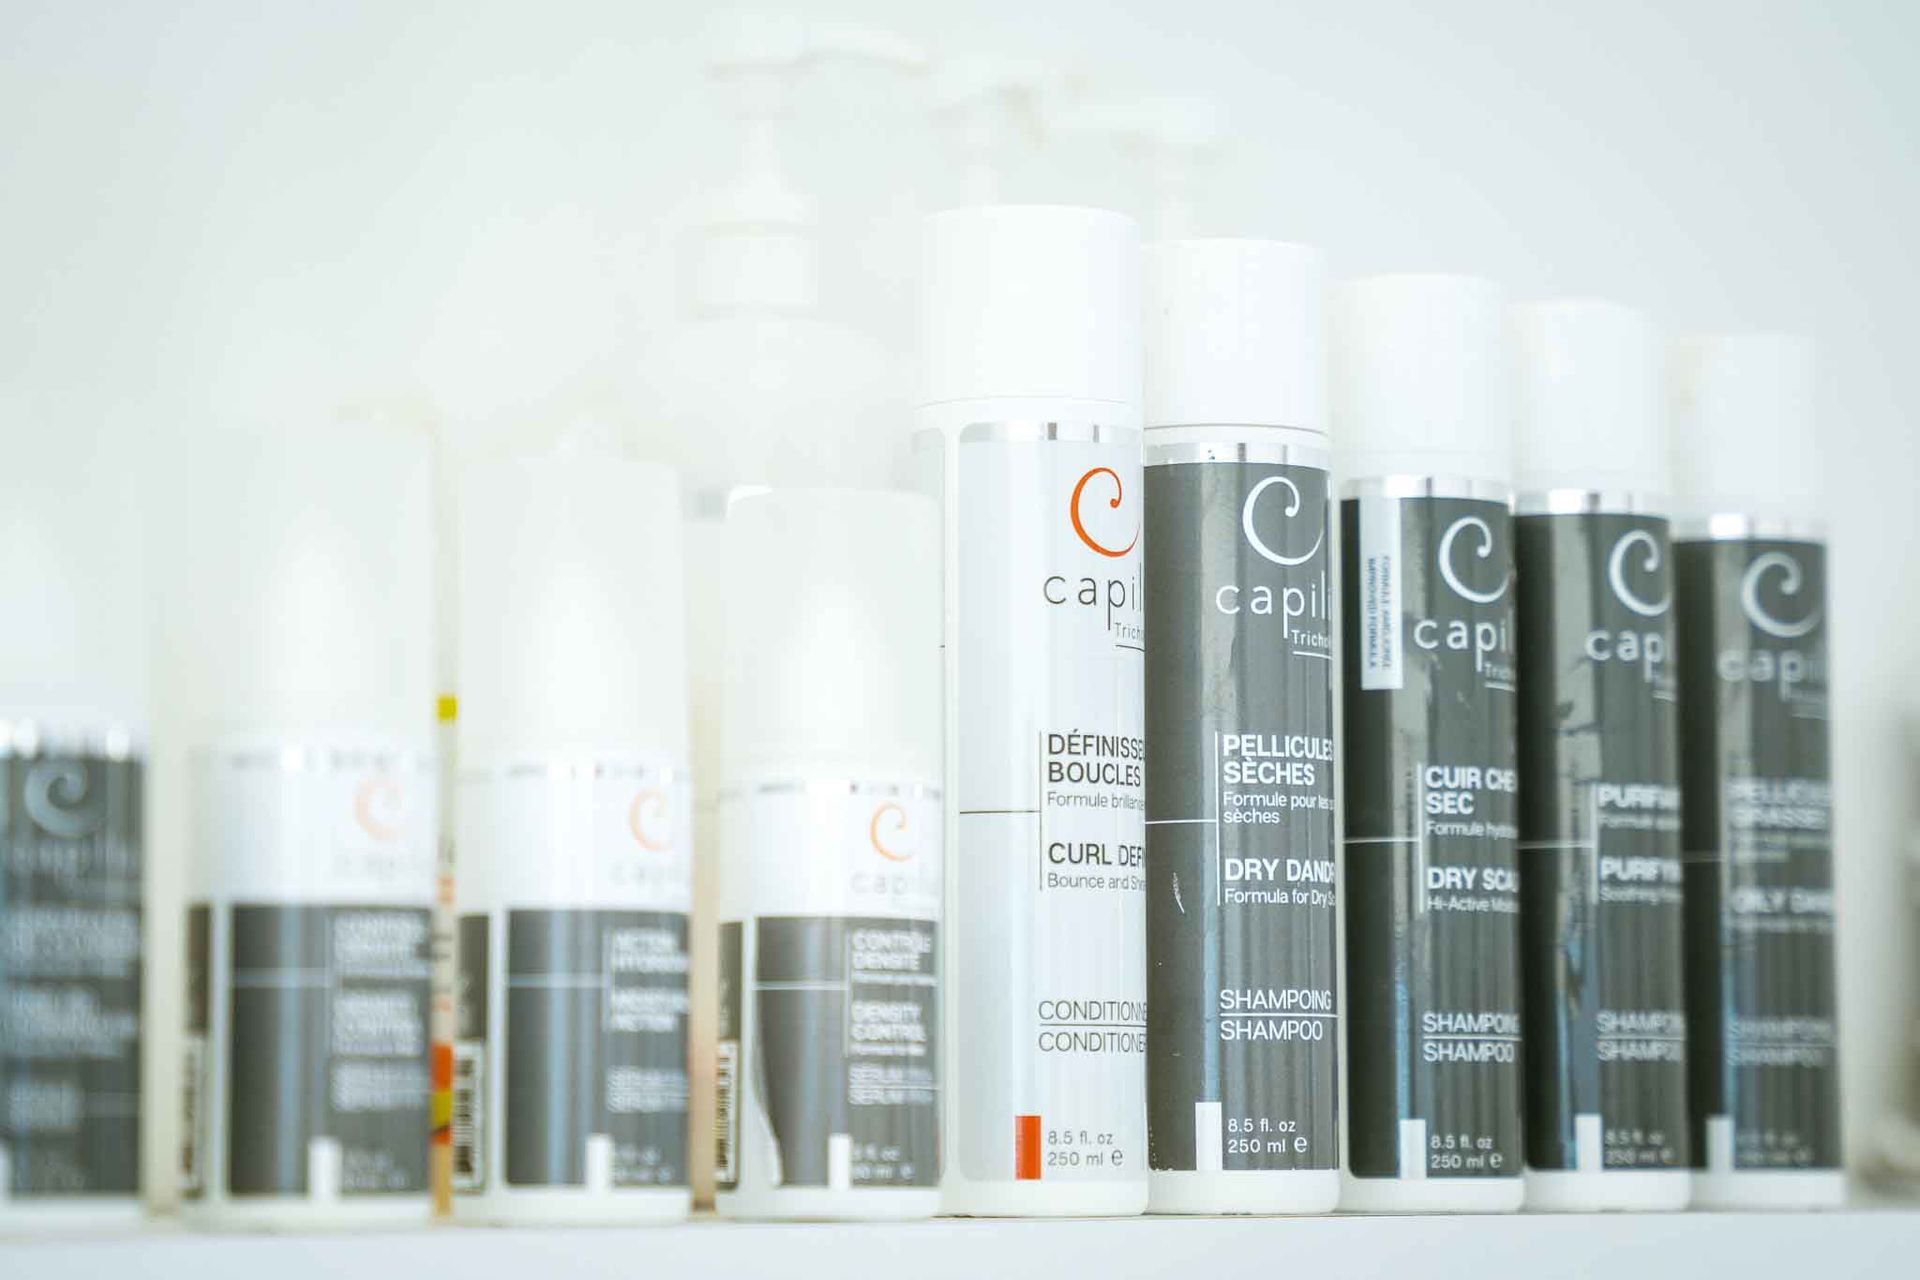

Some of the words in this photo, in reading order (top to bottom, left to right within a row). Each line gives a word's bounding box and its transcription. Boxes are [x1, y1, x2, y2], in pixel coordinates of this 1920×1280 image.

[1586, 630, 1666, 683] cap
[1048, 761, 1141, 787] BOUCLES
[1223, 757, 1315, 786] SÈCHES
[1425, 766, 1481, 789] CUIR
[1047, 791, 1108, 808] Formule
[1223, 791, 1288, 807] Formule
[1291, 795, 1317, 811] pour
[1426, 791, 1474, 815] SEC
[1223, 808, 1281, 824] sèches
[1049, 843, 1112, 866] CURL
[1225, 858, 1280, 881] DRY
[1428, 867, 1477, 890] DRY
[1048, 872, 1105, 889] Bounce
[1108, 874, 1129, 890] and
[1225, 888, 1289, 904] Formula
[1292, 889, 1309, 904] for
[1311, 889, 1328, 908] Dry
[1220, 989, 1332, 1011] SHAMPOING
[1220, 1020, 1323, 1041] SHAMPOO
[1423, 1042, 1515, 1062] SHAMPOO
[1228, 1118, 1253, 1132] 8.5
[1260, 1118, 1273, 1132] fl.
[1279, 1121, 1296, 1132] oz
[1048, 1131, 1073, 1145] 8.5
[1097, 1133, 1113, 1145] oz
[1228, 1139, 1261, 1153] 250
[1267, 1139, 1286, 1153] ml
[1431, 1135, 1455, 1149] 8.5
[1048, 1152, 1080, 1166] 250
[1086, 1152, 1103, 1166] ml
[1431, 1155, 1461, 1169] 250
[1466, 1155, 1484, 1168] ml
